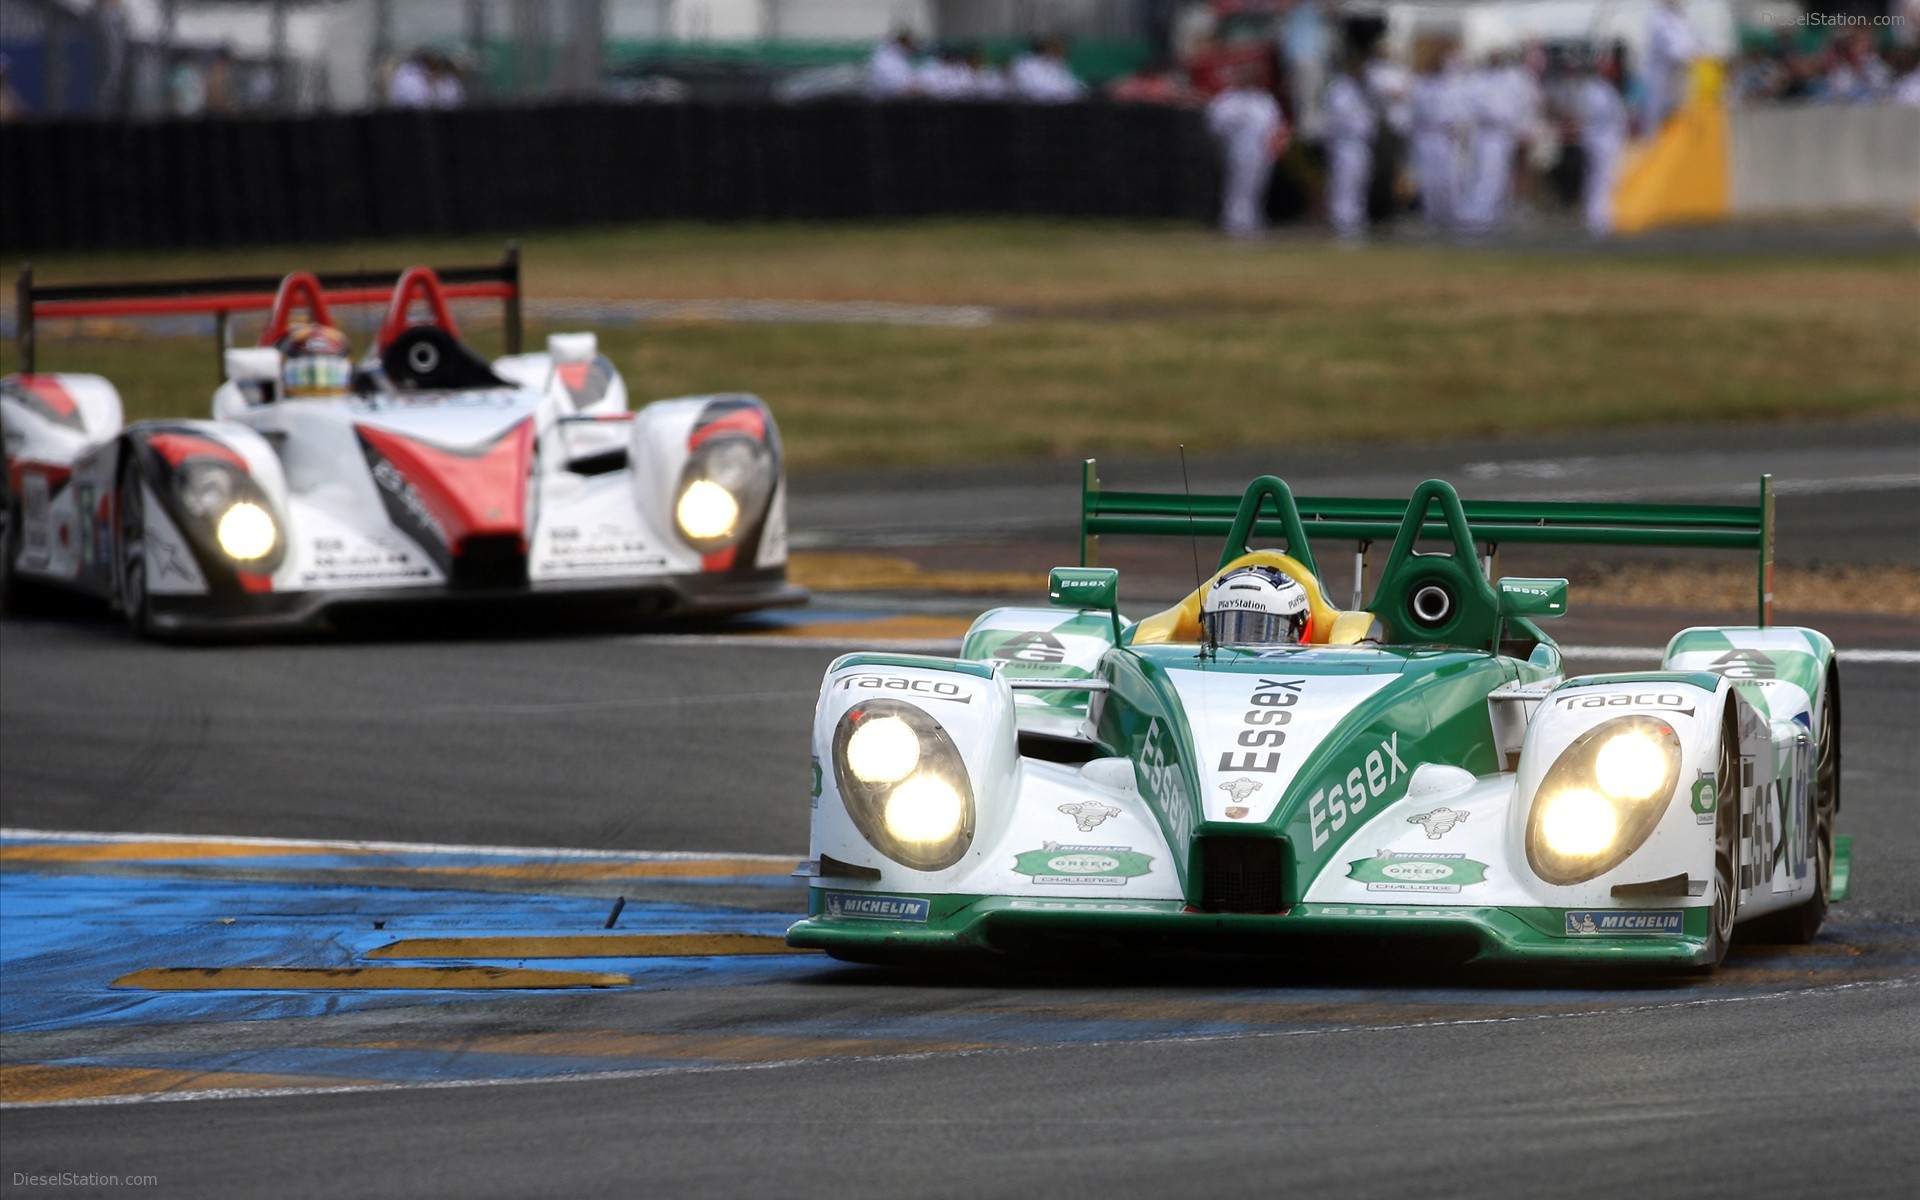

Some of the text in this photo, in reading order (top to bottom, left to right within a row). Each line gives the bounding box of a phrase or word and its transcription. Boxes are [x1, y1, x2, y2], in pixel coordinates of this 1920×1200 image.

[1061, 580, 1106, 588] Essex
[1502, 585, 1549, 597] Essex
[993, 660, 1061, 671] Trailer
[836, 674, 962, 697] raaco
[1559, 692, 1687, 711] raaco
[1218, 679, 1306, 773] Essex
[1140, 717, 1185, 850] Essex
[1309, 731, 1408, 852] Essex
[844, 899, 921, 915] MICHELIN
[1600, 916, 1679, 928] MICHELIN
